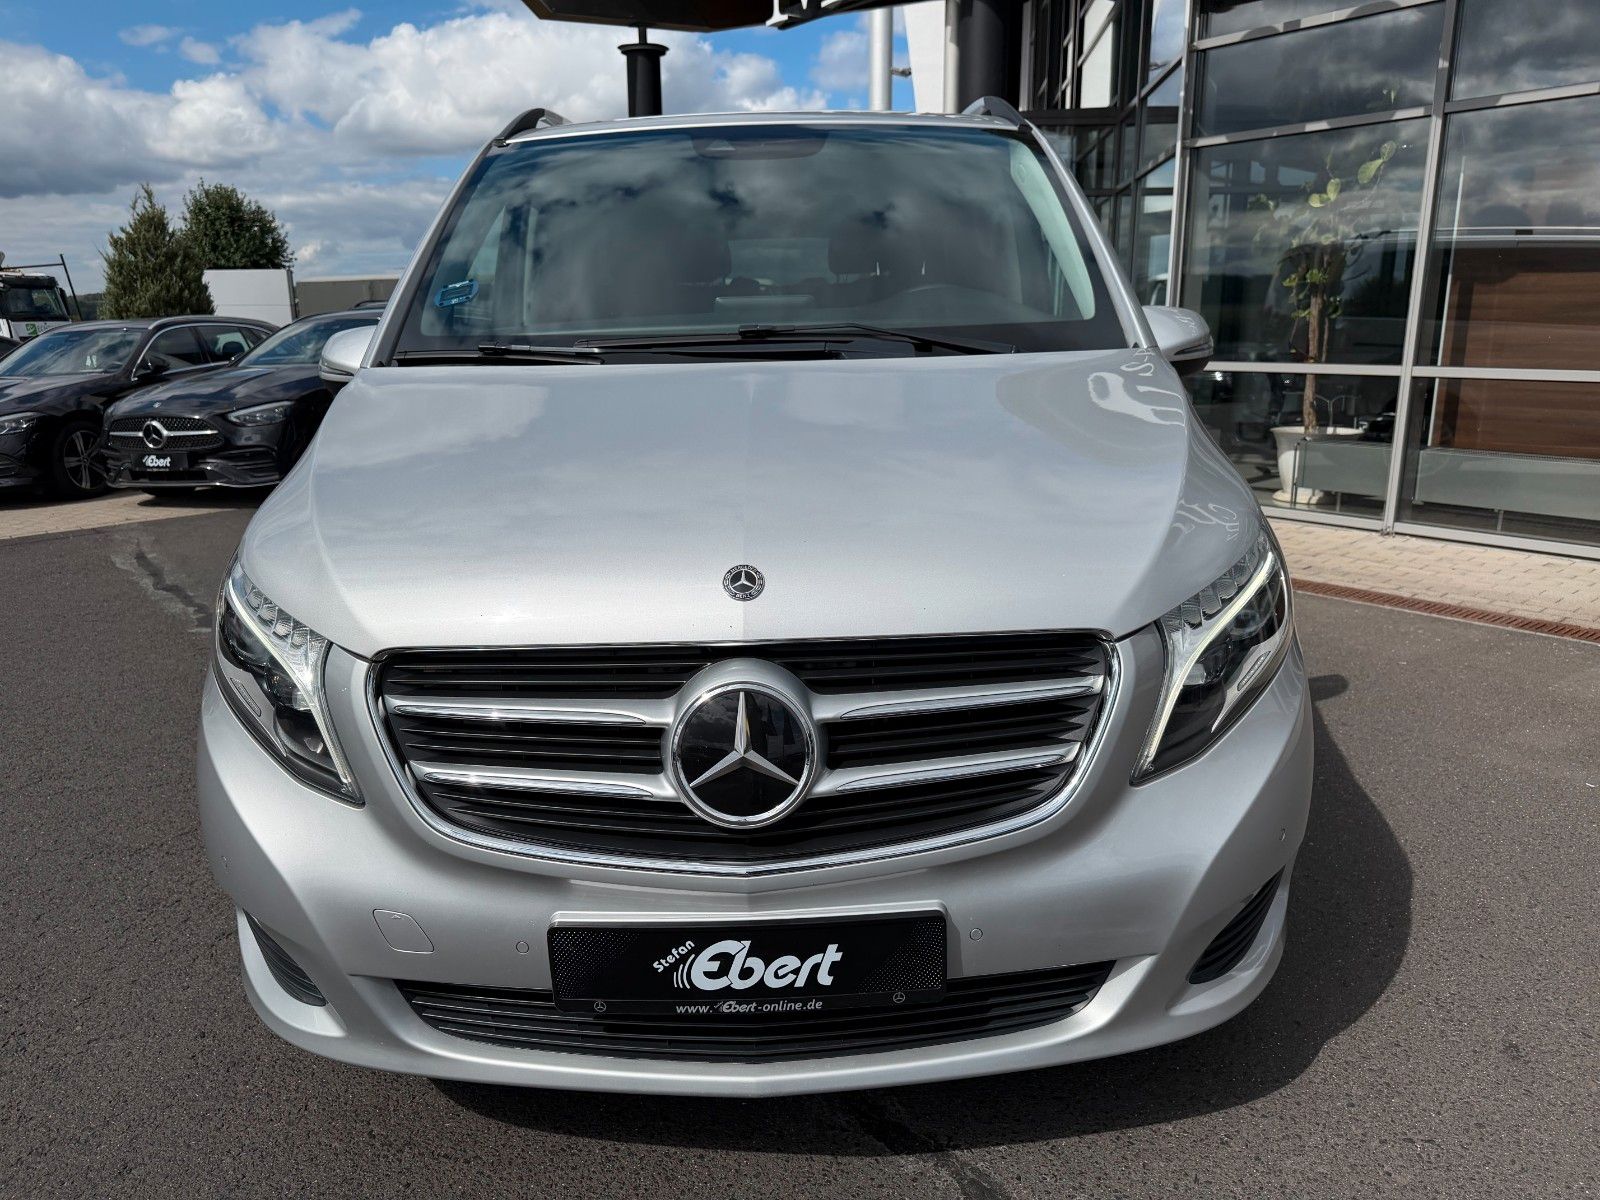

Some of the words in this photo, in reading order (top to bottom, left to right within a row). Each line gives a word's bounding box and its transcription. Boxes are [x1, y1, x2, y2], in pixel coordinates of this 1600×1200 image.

[146, 455, 171, 467] Ebert
[652, 940, 695, 973] Stefan
[690, 939, 843, 991] Ebert
[676, 999, 823, 1014] www.Ebert-online.de
